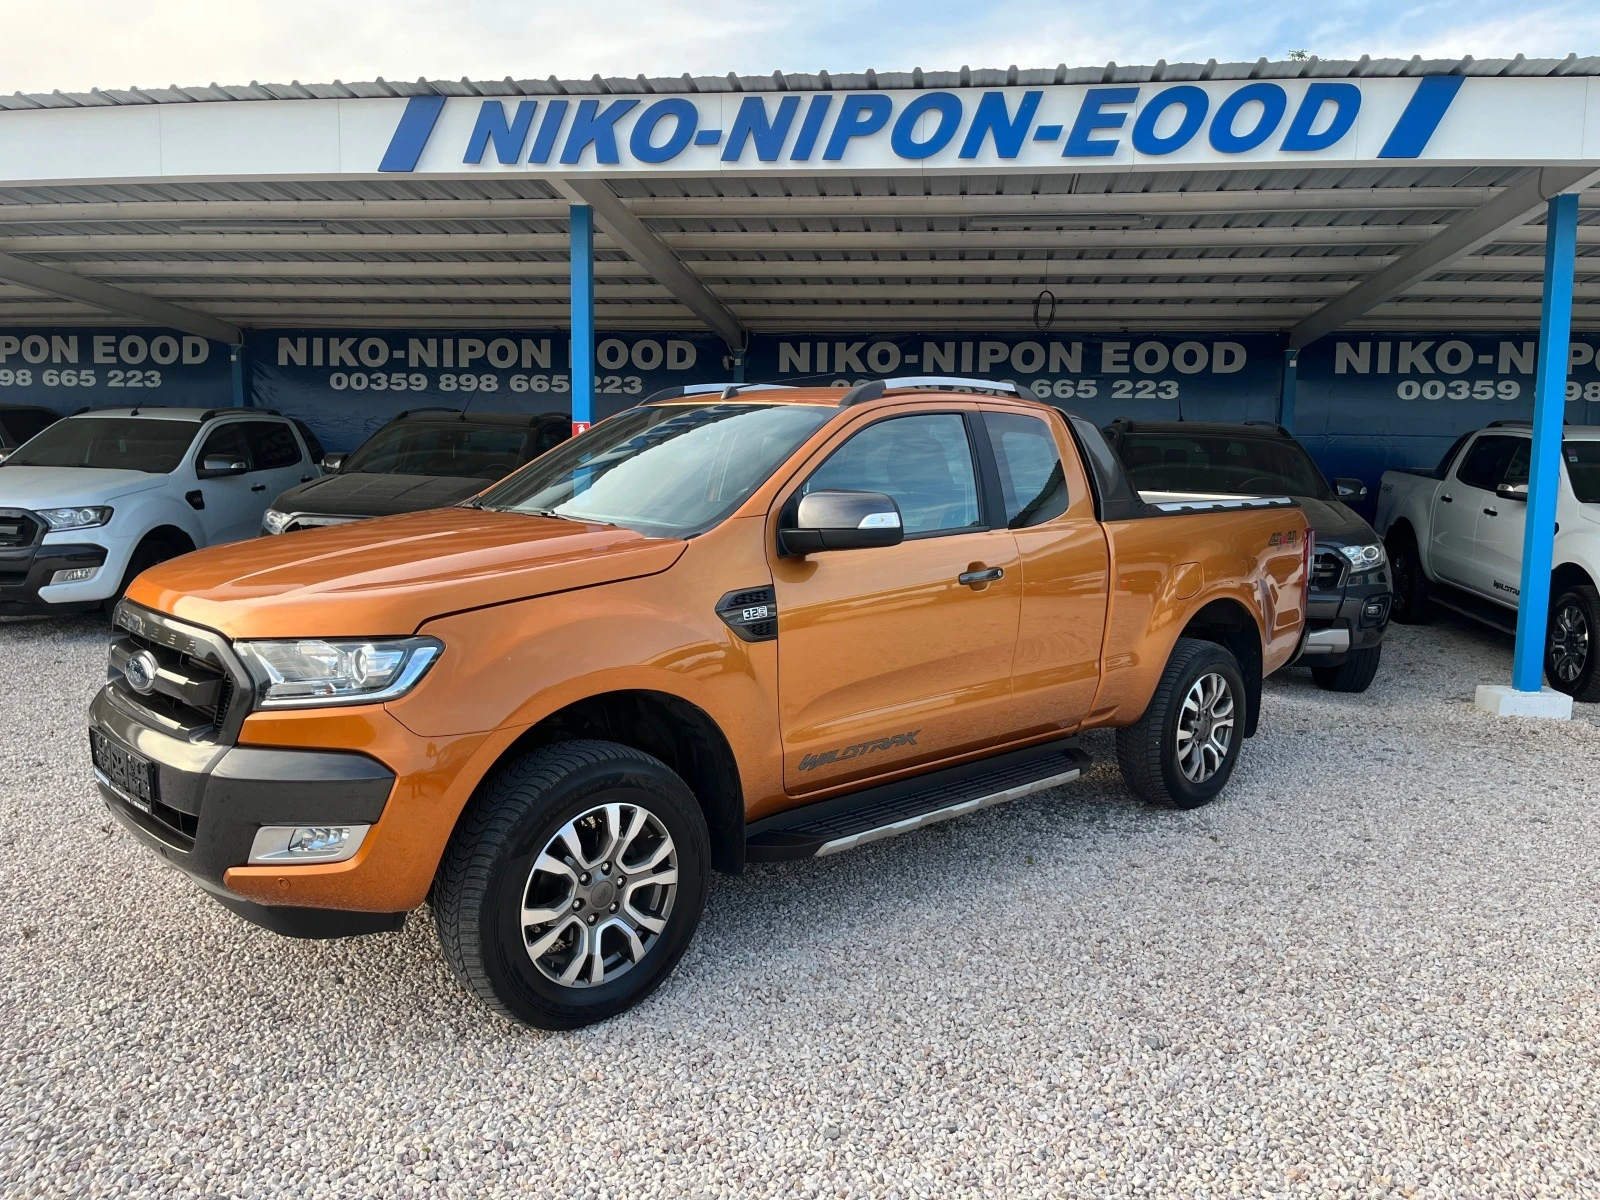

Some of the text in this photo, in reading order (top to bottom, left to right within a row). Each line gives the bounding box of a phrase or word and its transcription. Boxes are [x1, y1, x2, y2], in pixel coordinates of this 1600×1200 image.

[462, 82, 1362, 165] NIKO-NIPON-EOOD
[93, 334, 209, 365] EOOD
[277, 337, 697, 370] NIKO-NIPON OOD
[778, 340, 1247, 374] NIKO-NIPON EOOD
[1334, 341, 1600, 375] NIKO-NP
[42, 369, 97, 387] 665
[107, 370, 162, 388] 223
[329, 372, 428, 391] 00359
[438, 373, 499, 392] 898
[509, 374, 570, 393] 665
[1030, 379, 1098, 398] 665
[1111, 379, 1179, 399] 223
[1397, 380, 1600, 401] 00359 98
[798, 729, 922, 771] WILDTRAK
